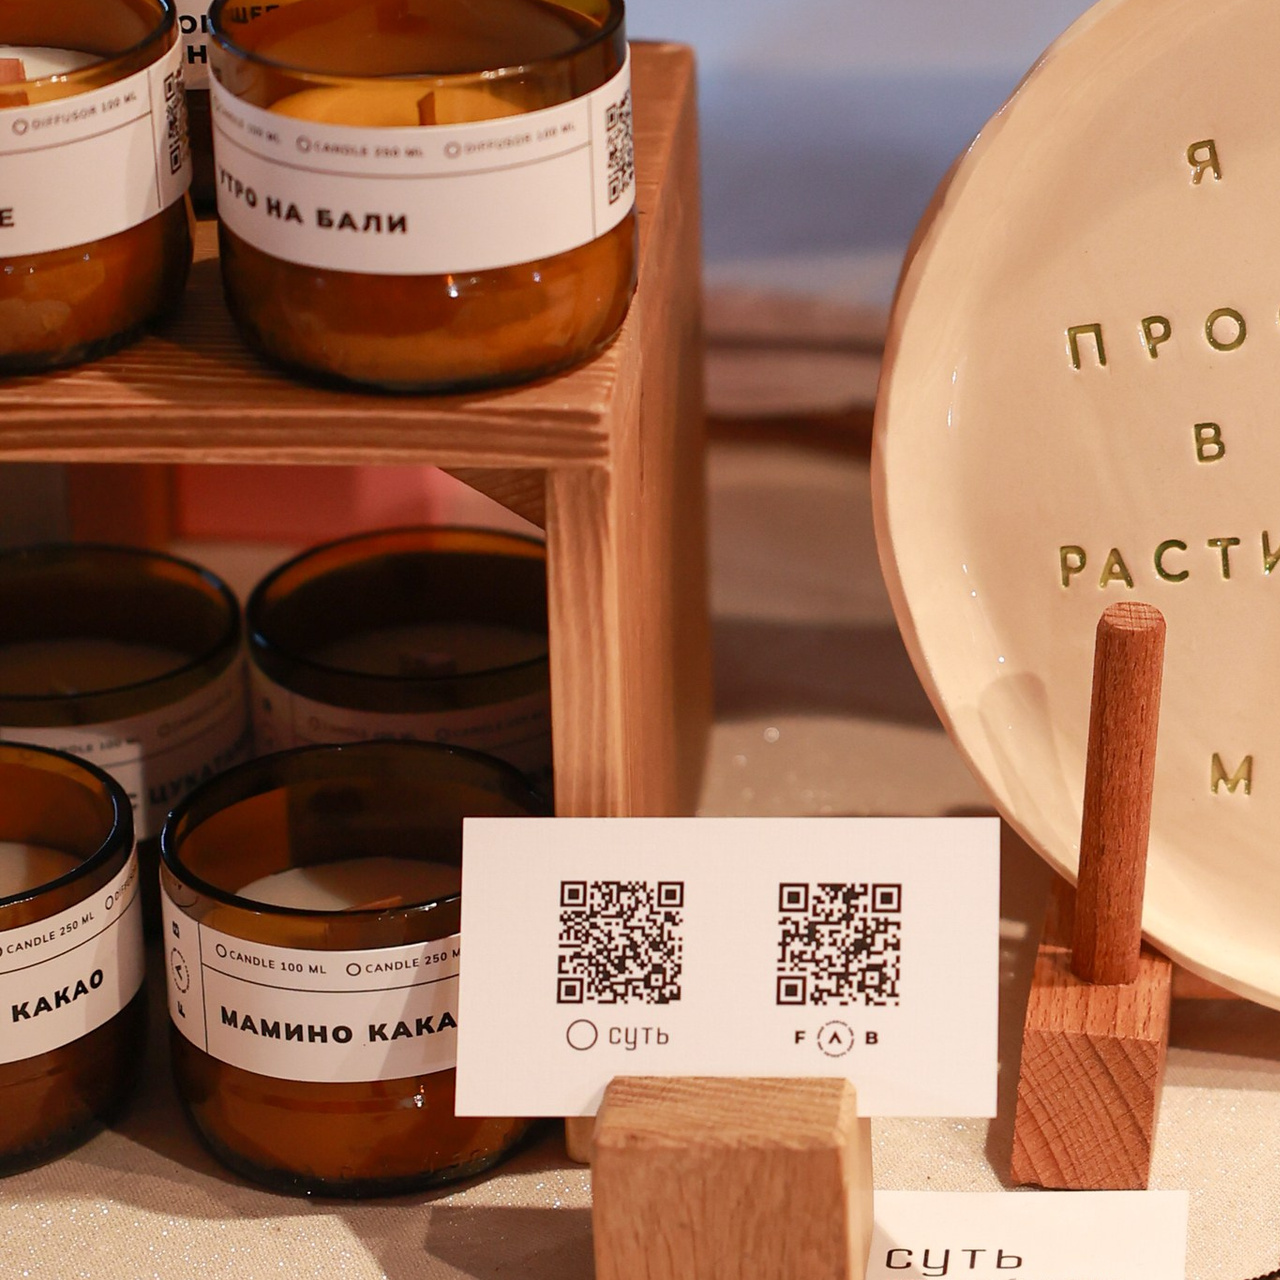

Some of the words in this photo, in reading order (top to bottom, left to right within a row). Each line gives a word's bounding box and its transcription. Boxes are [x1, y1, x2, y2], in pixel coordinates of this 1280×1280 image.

[1186, 137, 1222, 185] Я
[219, 164, 258, 209] УТРО
[266, 196, 304, 224] НА
[316, 208, 409, 234] БАЛИ
[1193, 421, 1226, 464] В
[7, 931, 56, 954] CANDLE
[60, 920, 79, 936] 250
[82, 911, 95, 925] ML
[229, 950, 275, 969] CANDLE
[281, 961, 303, 973] 100
[309, 964, 327, 974] ML
[365, 958, 420, 973] CANDLE
[424, 951, 448, 965] 250
[11, 968, 104, 1023] КАКАО
[220, 1005, 353, 1043] МАМИНО
[368, 1011, 458, 1042] КАКА
